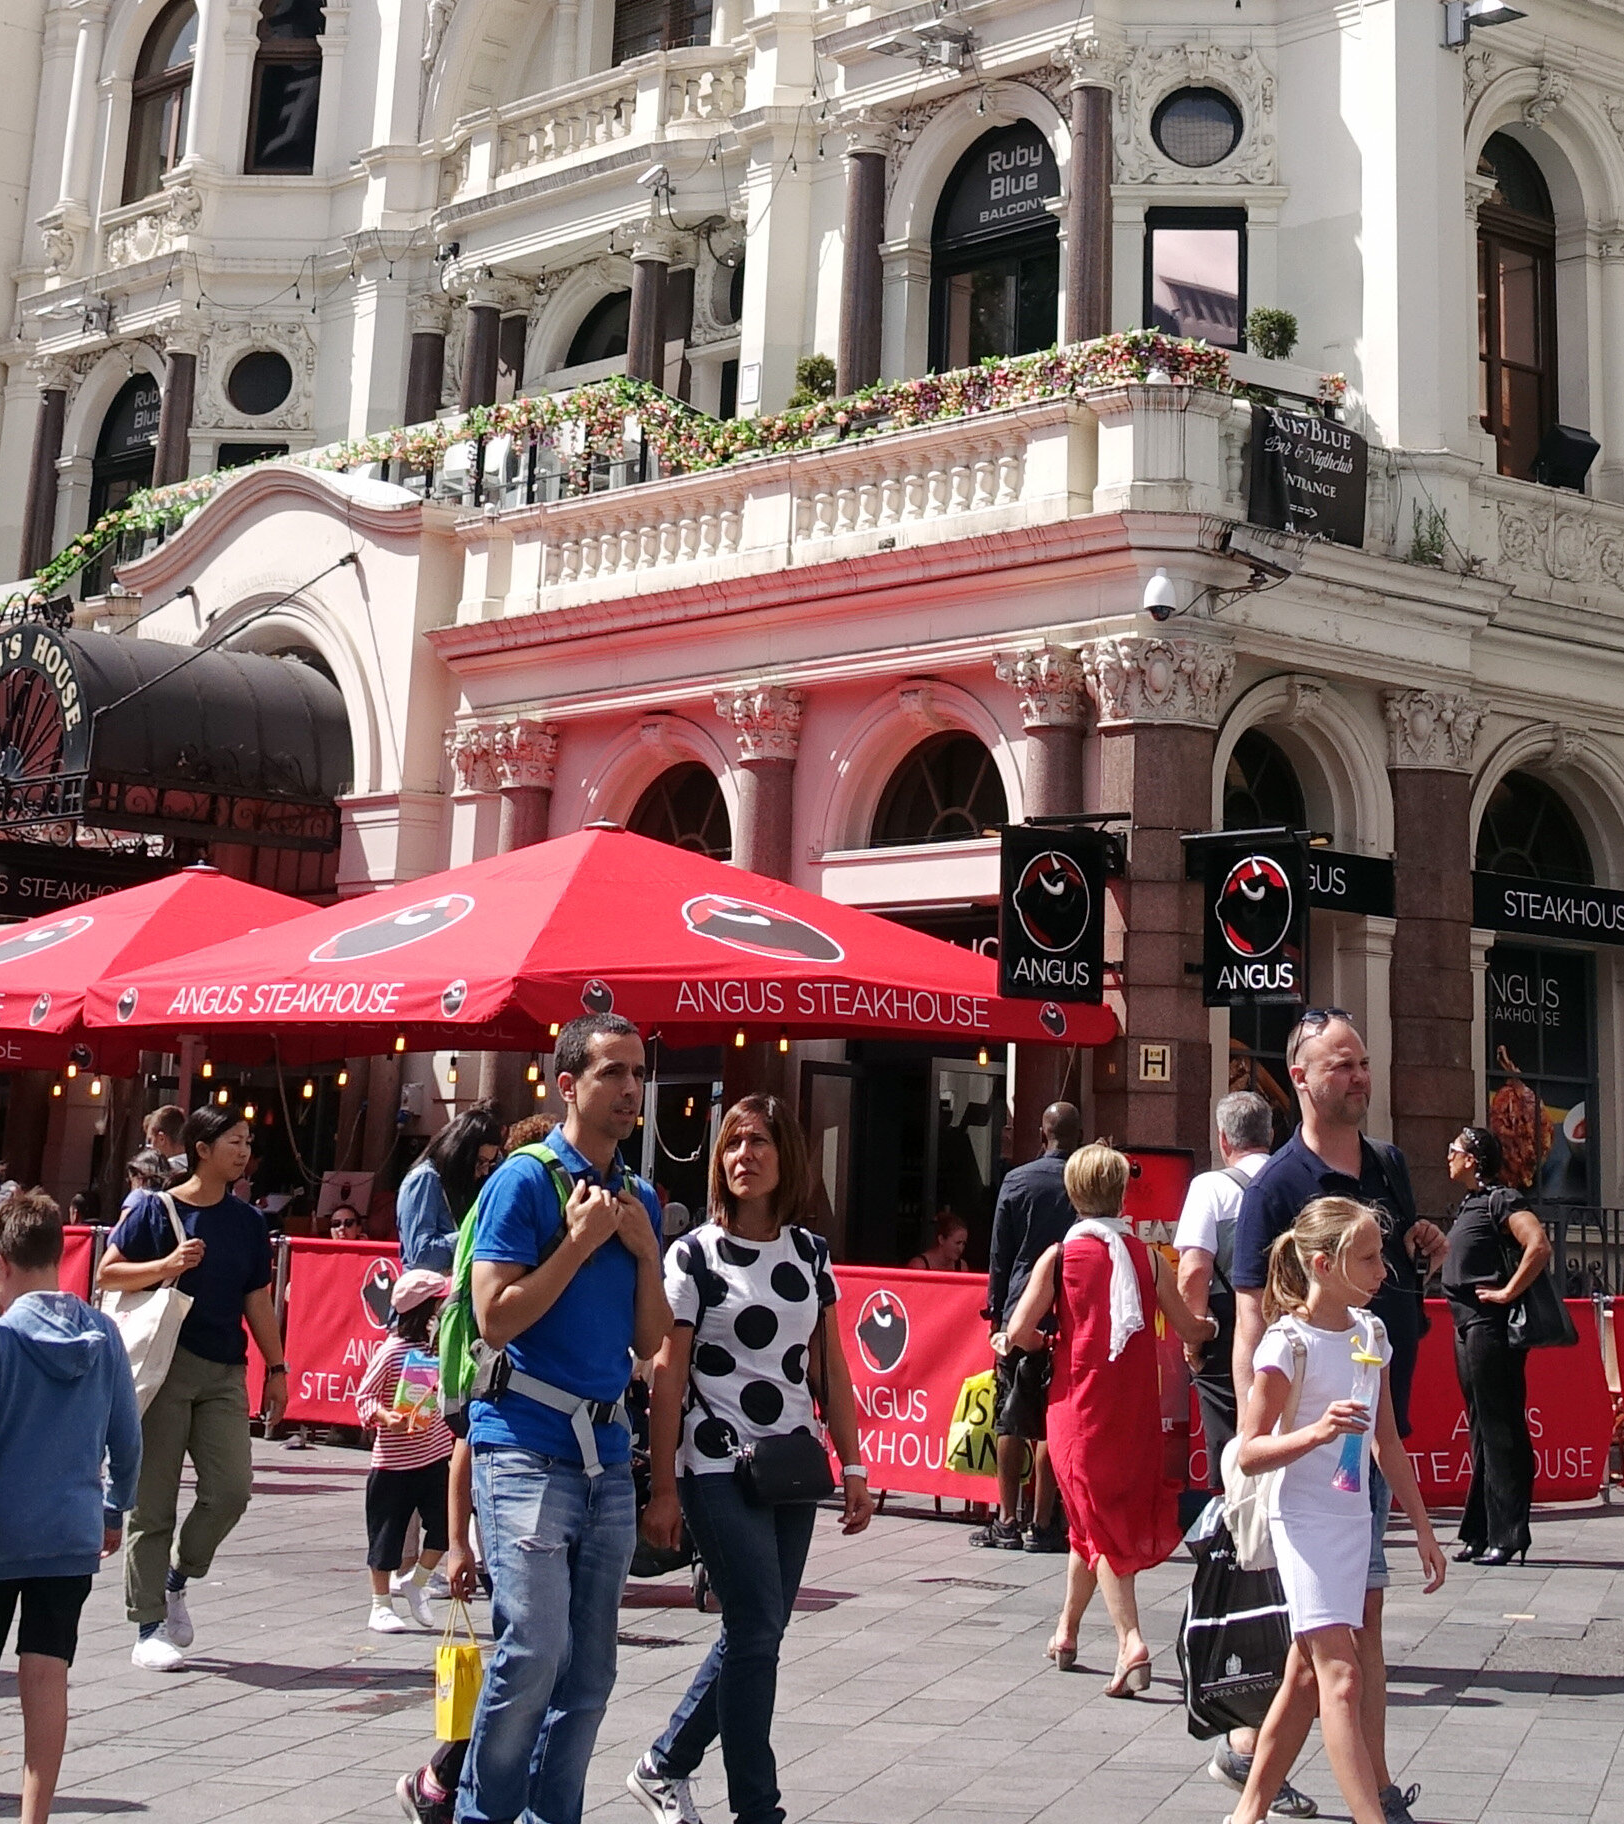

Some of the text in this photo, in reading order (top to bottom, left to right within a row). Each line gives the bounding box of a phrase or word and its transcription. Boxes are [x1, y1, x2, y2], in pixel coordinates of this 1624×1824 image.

[987, 143, 1043, 175] Ruby
[990, 172, 1039, 201] Blue
[979, 195, 1048, 223] BALCONY
[1310, 418, 1352, 451] BLUE
[32, 633, 82, 732] HOUSE
[1013, 957, 1090, 987] ANGUS
[1217, 962, 1294, 990] ANGUS
[167, 982, 405, 1016] ANGUS STEAKHOUSE
[675, 980, 991, 1029] ANGUS STEAKHOUSE
